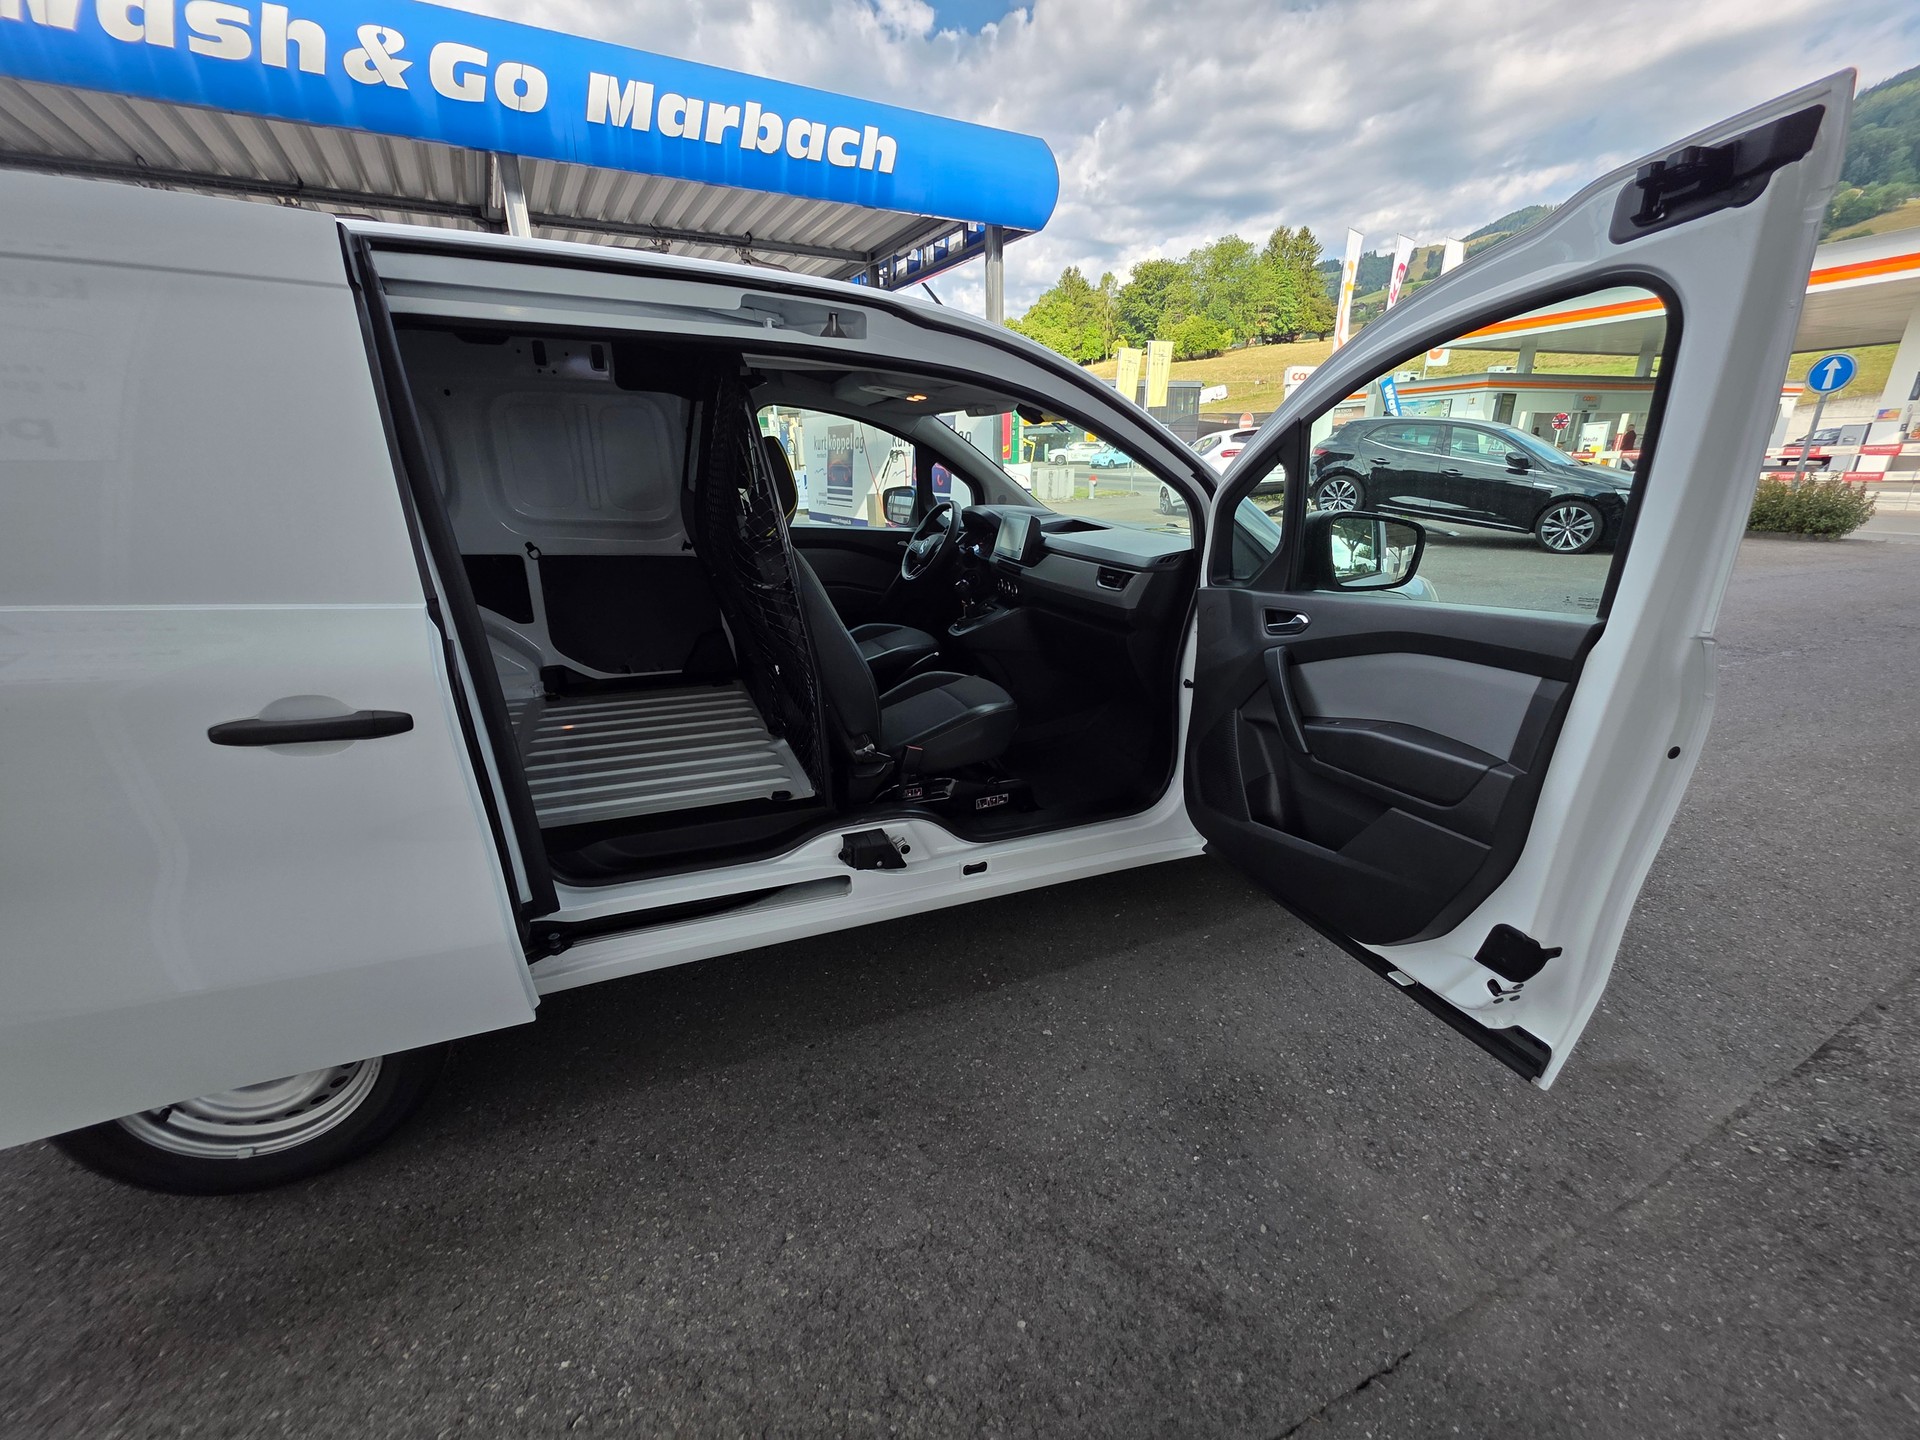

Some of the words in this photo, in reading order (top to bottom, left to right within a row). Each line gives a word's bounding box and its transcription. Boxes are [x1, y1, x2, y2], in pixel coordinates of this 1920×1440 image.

[342, 24, 414, 90] &
[428, 41, 549, 114] Go
[586, 71, 898, 175] Marbach
[1292, 372, 1310, 382] co
[814, 435, 827, 451] kurt
[828, 433, 853, 454] köppel
[854, 436, 865, 453] ag
[892, 436, 911, 448] kur
